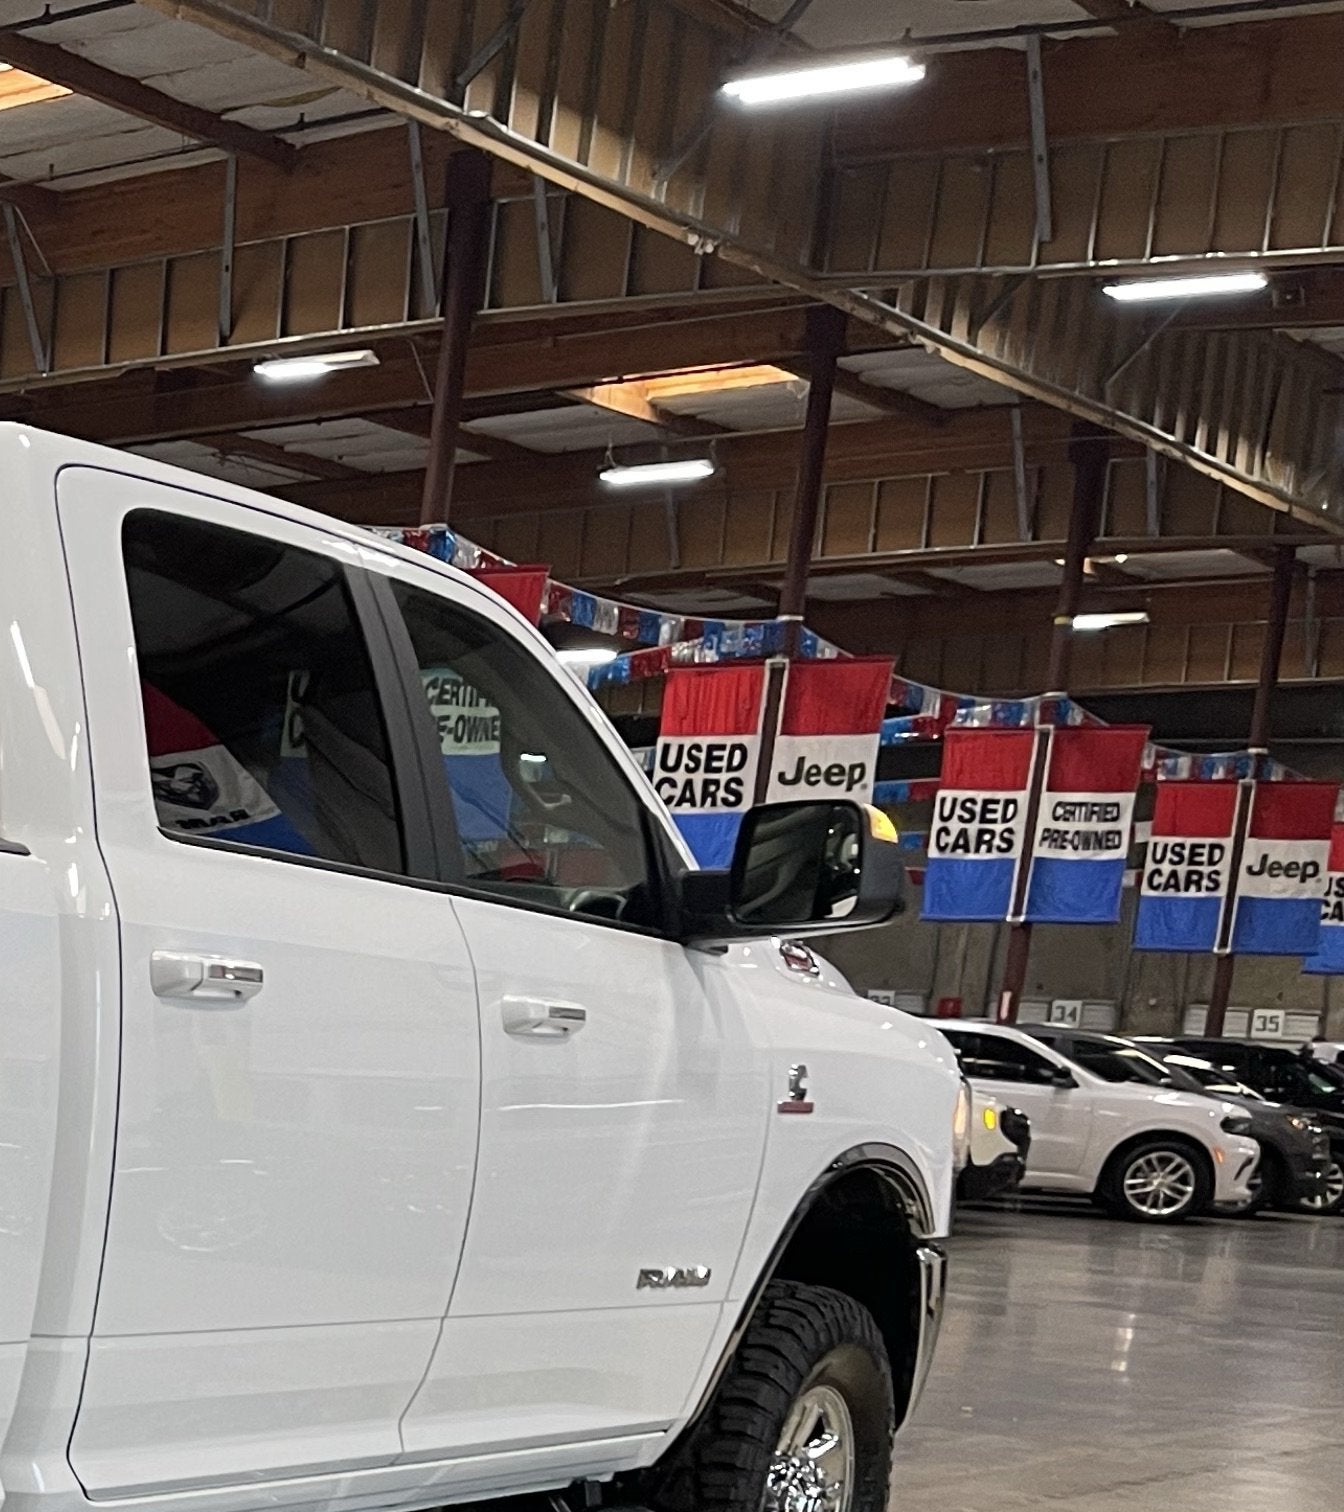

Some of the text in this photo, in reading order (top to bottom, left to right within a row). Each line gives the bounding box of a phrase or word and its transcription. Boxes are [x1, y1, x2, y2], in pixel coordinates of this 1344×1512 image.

[659, 742, 748, 774] USED
[777, 756, 867, 792] Jeep
[654, 776, 745, 808] CARS
[938, 796, 1018, 824] USED
[935, 826, 1016, 853] CARS
[1038, 828, 1123, 850] PRE-OWNED
[1150, 842, 1226, 867] USED
[1146, 868, 1221, 893] CARS
[1245, 853, 1320, 884] Jeep
[1054, 1005, 1078, 1023] 34
[1255, 1014, 1280, 1033] 35
